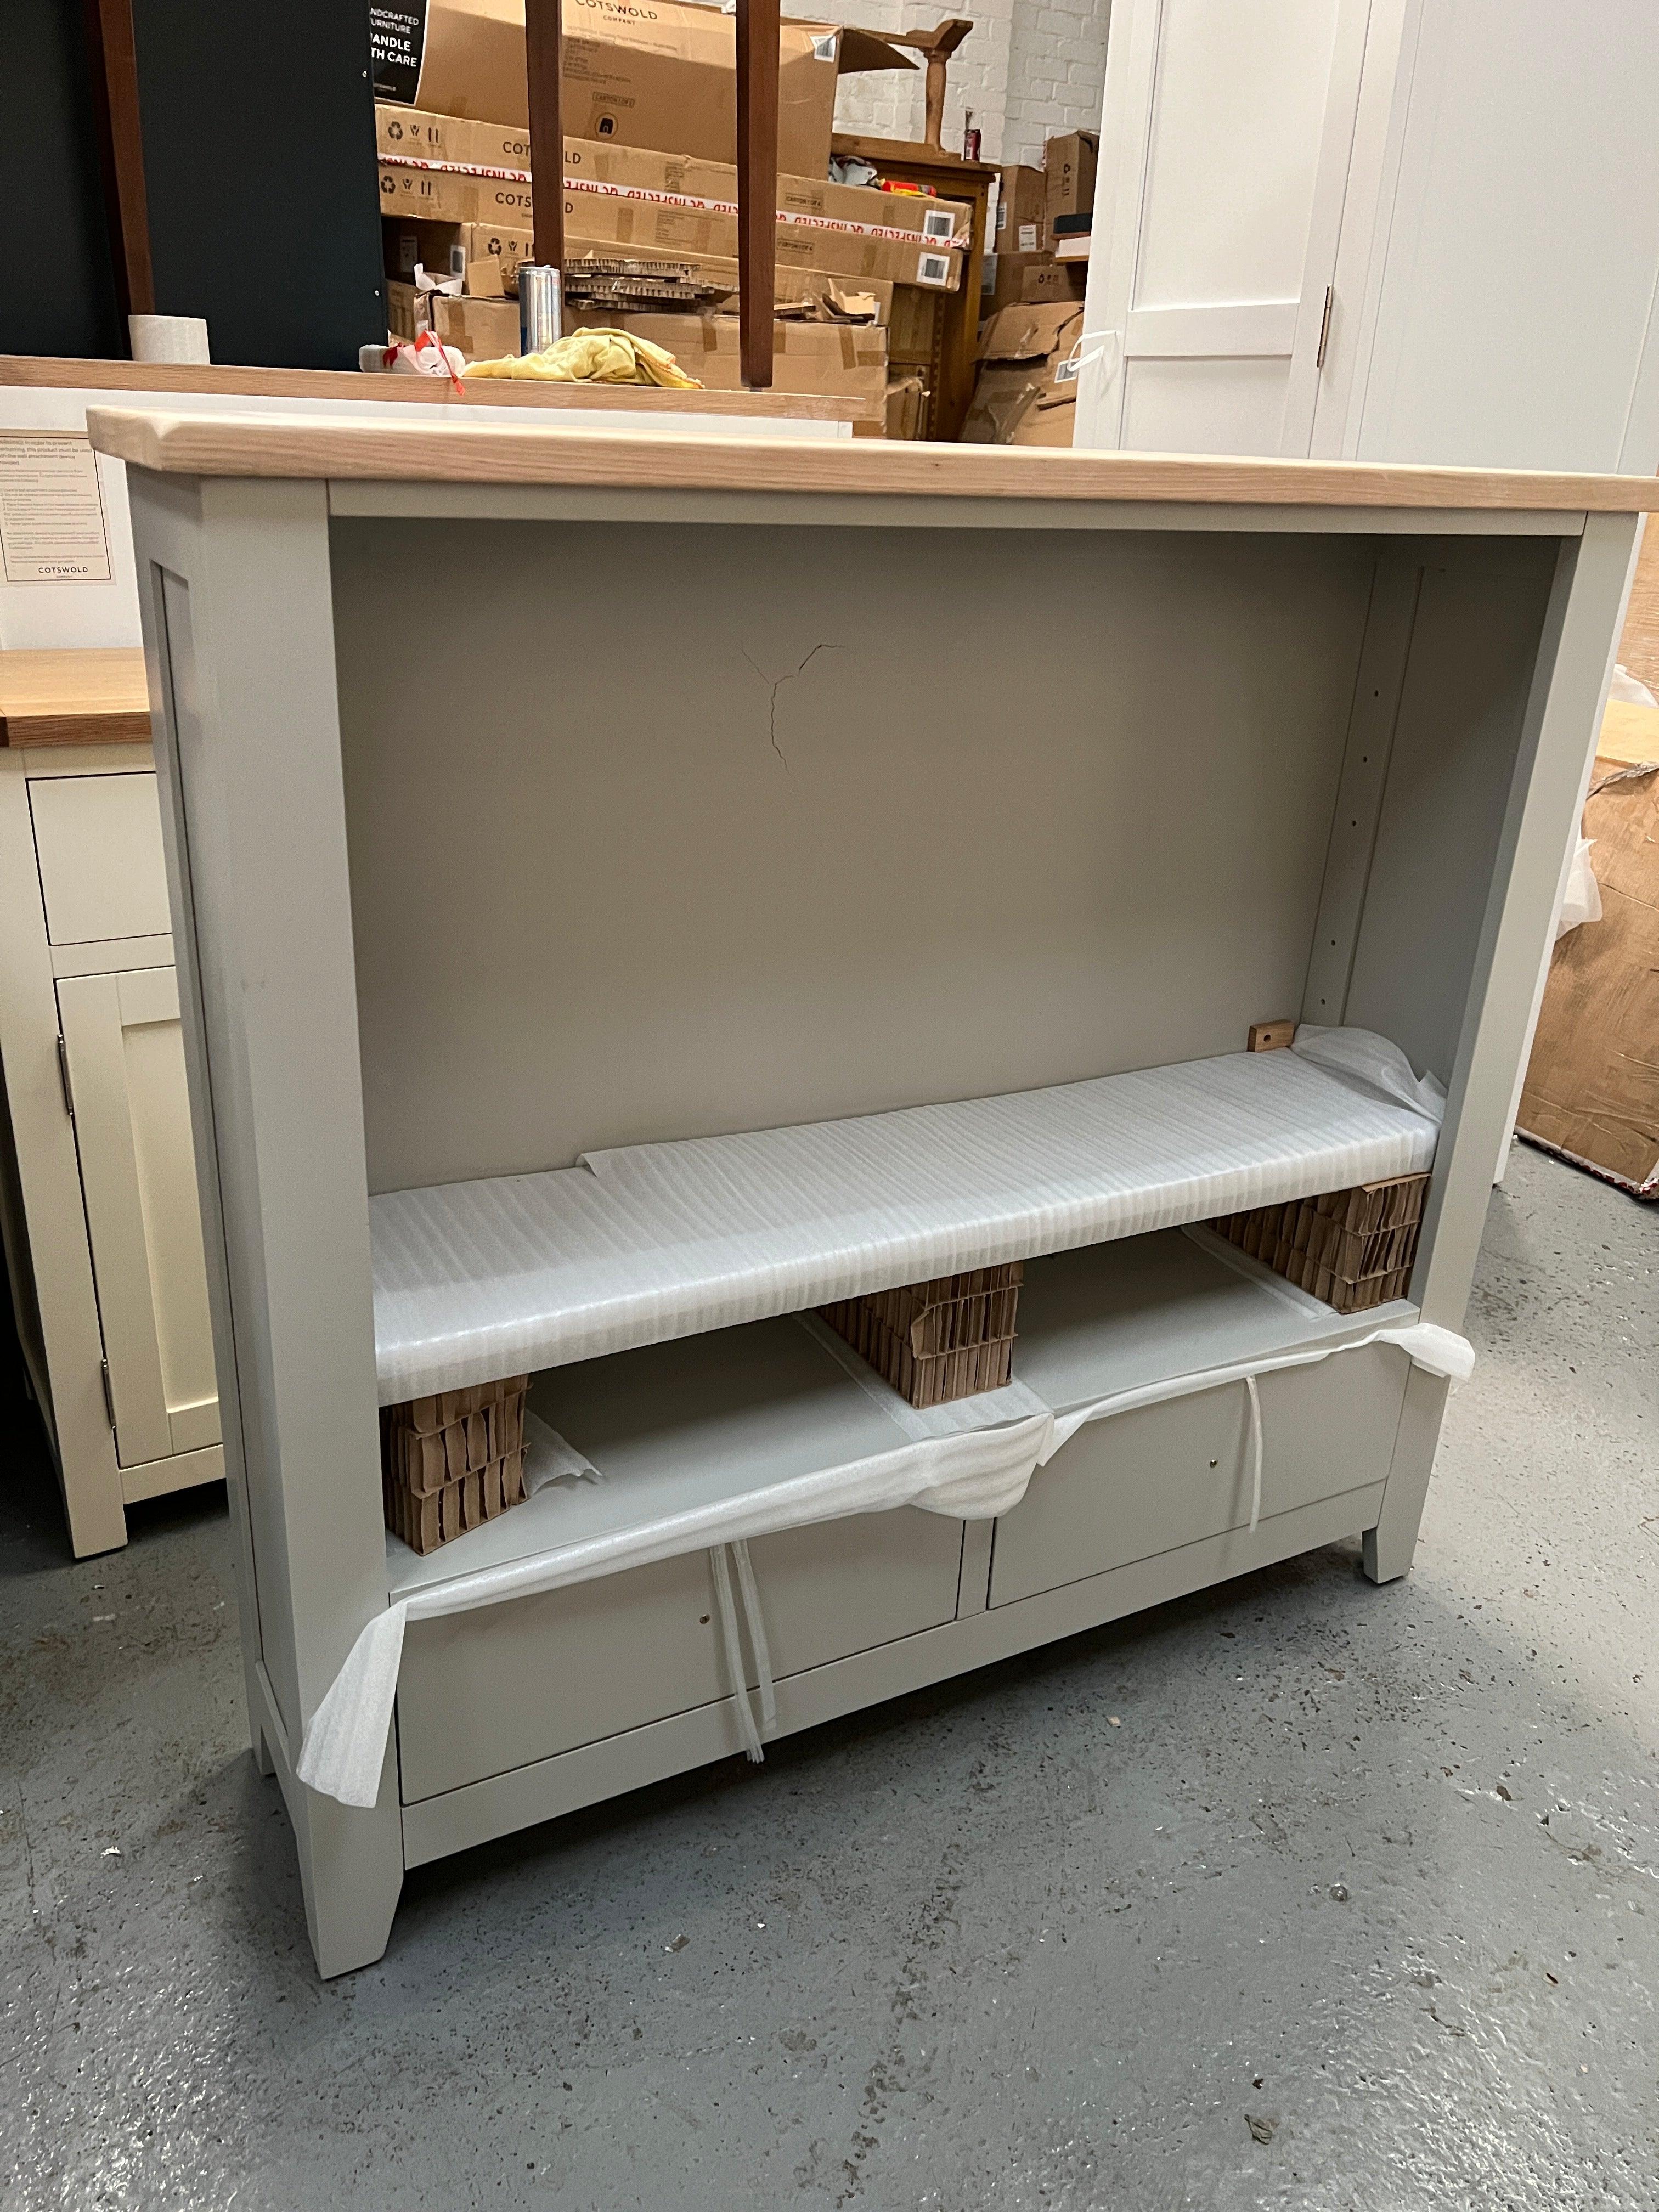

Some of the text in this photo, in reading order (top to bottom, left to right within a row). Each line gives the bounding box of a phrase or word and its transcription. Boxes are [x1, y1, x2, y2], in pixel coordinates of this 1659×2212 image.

[370, 8, 419, 25] NDCRAFTED
[576, 0, 657, 20] COTSWOLD
[370, 18, 411, 34] URNITURE
[370, 33, 411, 52] ANDLE
[371, 47, 417, 67] TH CARE
